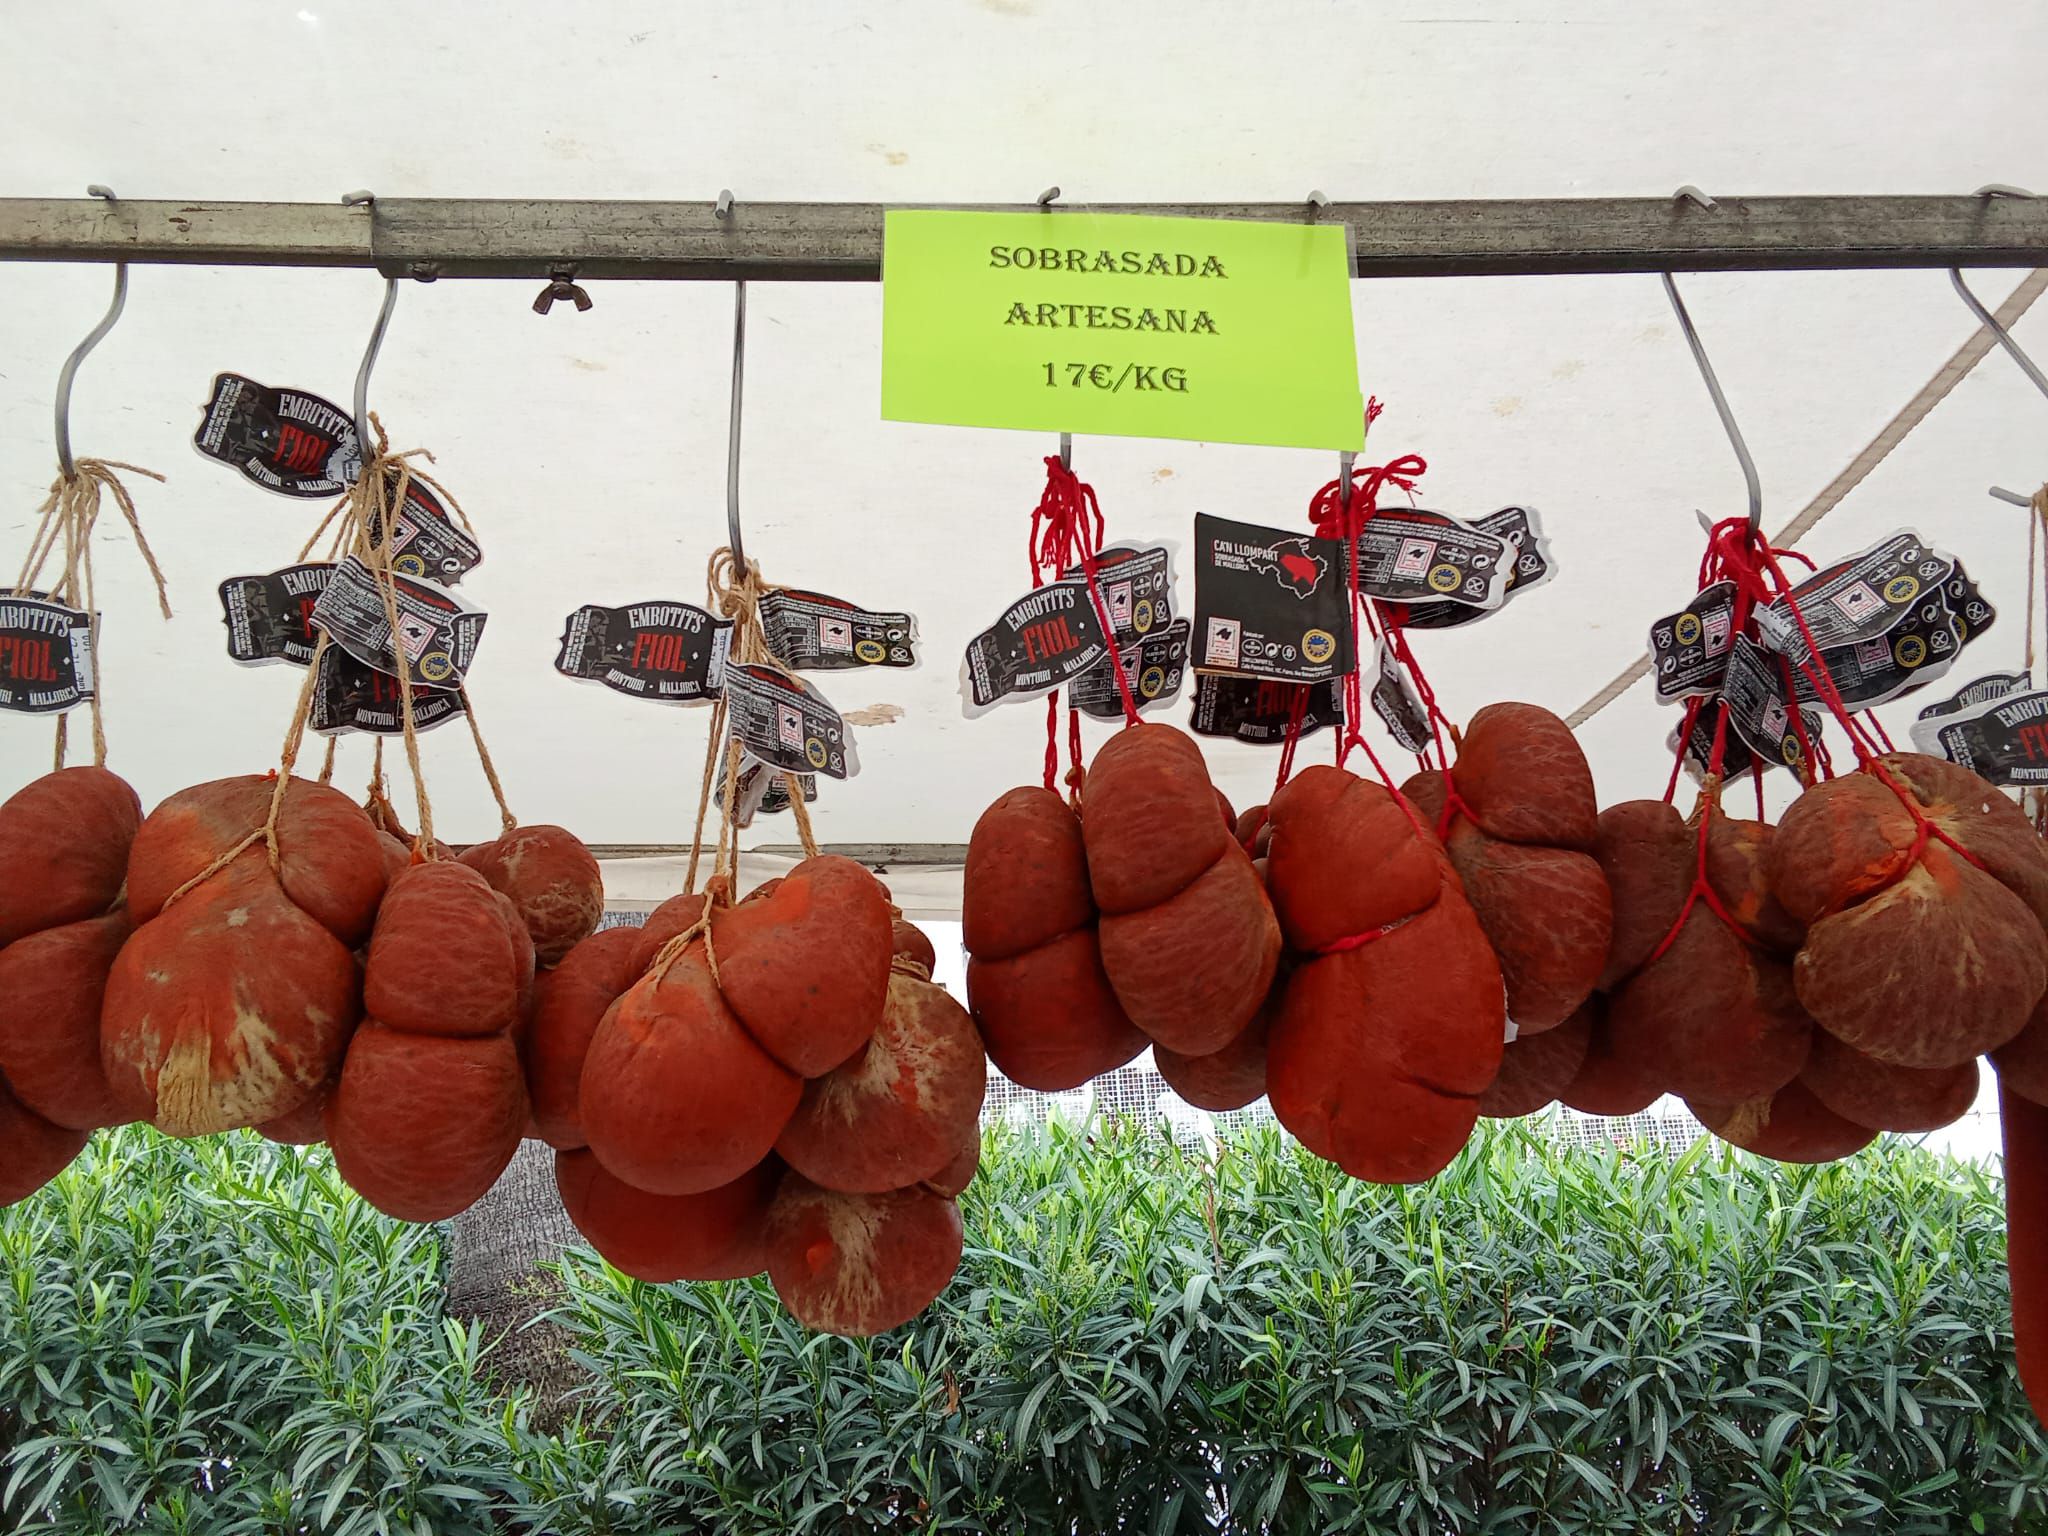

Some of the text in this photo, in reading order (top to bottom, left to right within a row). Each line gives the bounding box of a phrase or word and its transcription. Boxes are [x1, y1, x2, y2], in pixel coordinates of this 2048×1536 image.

[989, 245, 1229, 279] SOBRASADA
[1004, 302, 1220, 335] ARTESANA
[1041, 362, 1189, 393] 17€/KG
[277, 393, 355, 444] EMBOTITS
[272, 423, 330, 475] FIOL
[245, 456, 281, 487] MONTUIRI
[1234, 544, 1279, 562] LLOMPART
[628, 606, 706, 634] EMBOTITS
[1005, 587, 1075, 632] EMBOTITS
[631, 632, 687, 673] FIOL
[1022, 615, 1081, 665] FIOL
[606, 668, 702, 694] MONTUIRI MALLORCA
[1014, 668, 1052, 686] MONTUIRI
[1062, 643, 1102, 674] MALLORCA
[29, 685, 79, 706] MALLORCA
[1958, 679, 2010, 709] EMBOTITS
